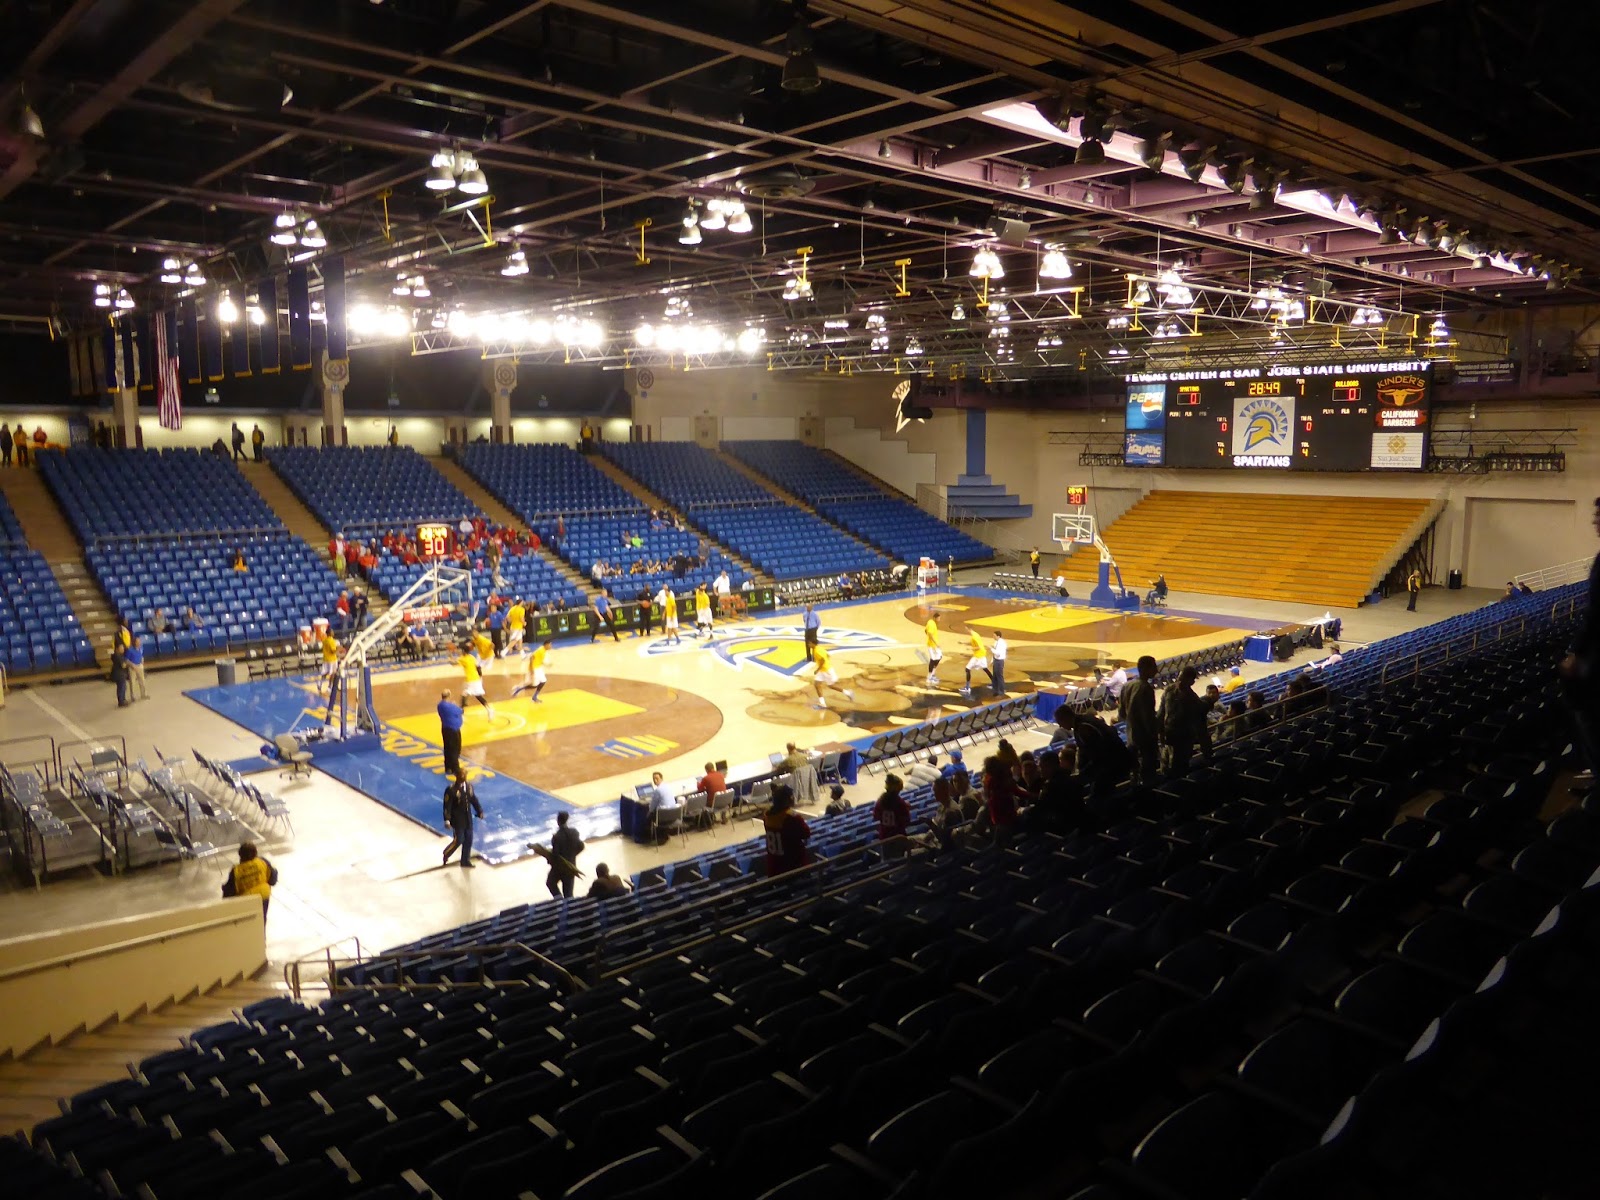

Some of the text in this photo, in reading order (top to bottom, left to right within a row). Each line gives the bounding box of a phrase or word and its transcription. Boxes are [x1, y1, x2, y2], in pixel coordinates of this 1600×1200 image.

[1169, 371, 1217, 380] CENTER
[1219, 370, 1231, 378] at
[1233, 368, 1260, 378] SAN
[1267, 365, 1301, 376] JOSE
[1302, 364, 1344, 375] STATE
[1346, 361, 1431, 373] UNIVERSITY
[1377, 375, 1426, 389] KINDER'S
[1248, 382, 1280, 395] 28:49
[1300, 385, 1304, 396] 1
[1348, 388, 1356, 400] 0
[1128, 391, 1164, 404] PEPSI
[1190, 392, 1196, 405] 0
[1381, 410, 1418, 418] CALIFORNIA
[1222, 422, 1227, 431] 0
[1306, 422, 1312, 431] 0
[1383, 418, 1416, 426] BARBECUE
[1128, 444, 1162, 456] AQUATIC
[1218, 448, 1224, 456] 4
[1302, 448, 1308, 456] 4
[1233, 456, 1290, 467] SPARTANS
[1070, 494, 1081, 504] 30
[424, 538, 444, 555] 30
[410, 610, 442, 620] NISSAN
